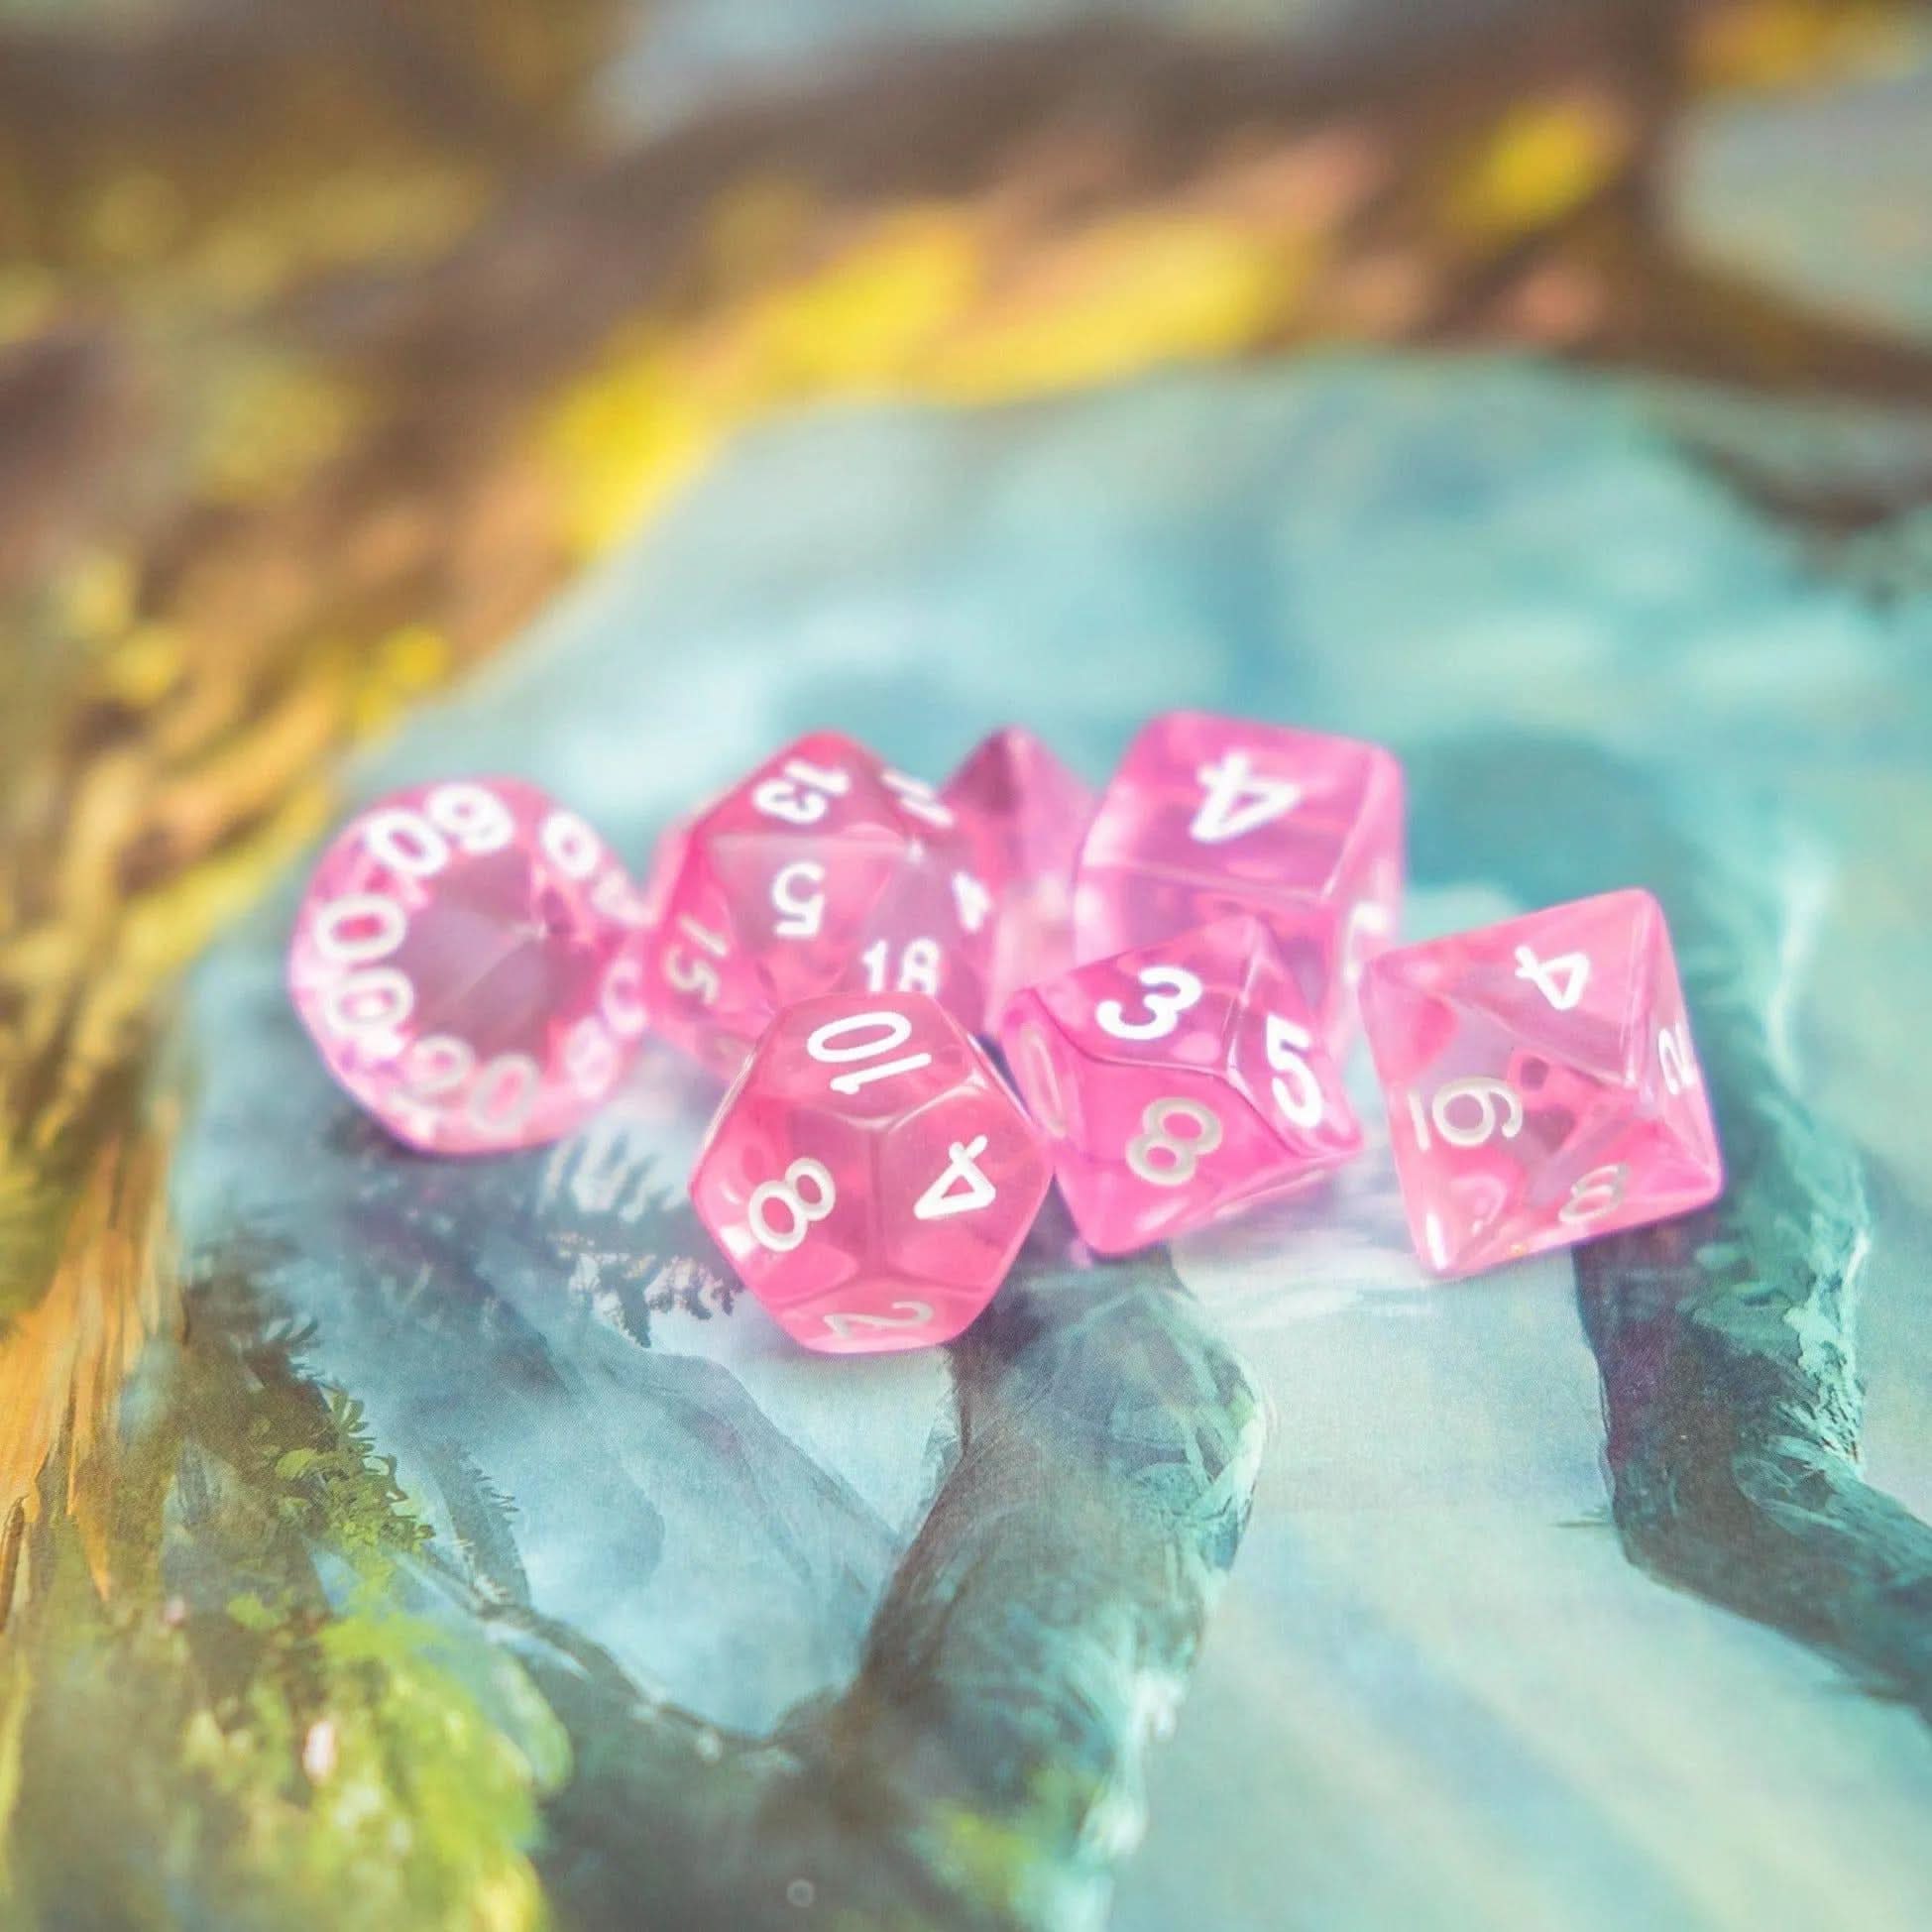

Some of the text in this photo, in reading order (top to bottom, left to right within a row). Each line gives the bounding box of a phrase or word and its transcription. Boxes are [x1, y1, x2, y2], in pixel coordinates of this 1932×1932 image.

[753, 759, 850, 825] 13
[1188, 747, 1302, 845] 4
[770, 860, 826, 937] 5
[860, 938, 943, 994] 18
[1094, 965, 1203, 1041] 3
[1514, 945, 1591, 1011] 4
[806, 1010, 932, 1094] 10
[1266, 1010, 1323, 1128] 5
[913, 1135, 997, 1219] 4
[1126, 1096, 1223, 1186] 8
[748, 1157, 836, 1252] 8
[823, 1301, 934, 1338] 2
